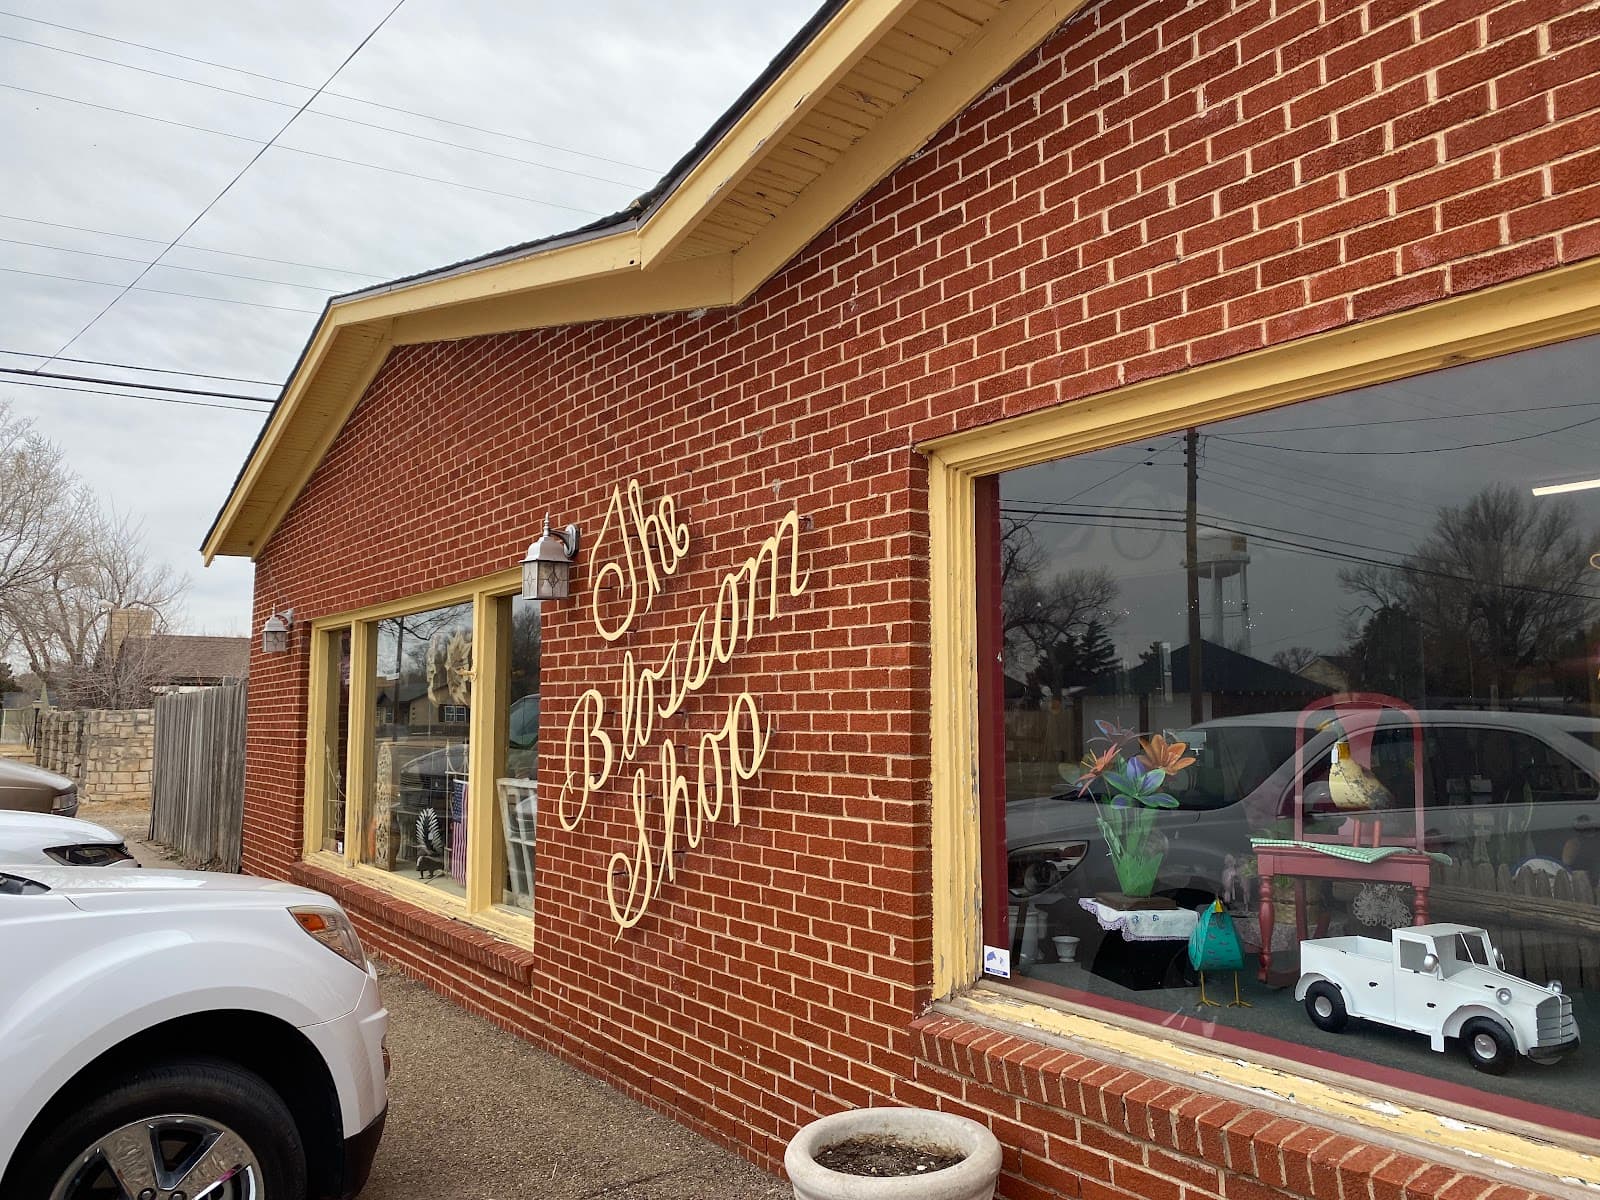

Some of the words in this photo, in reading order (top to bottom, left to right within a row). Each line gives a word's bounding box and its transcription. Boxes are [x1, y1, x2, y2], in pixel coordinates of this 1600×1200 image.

[559, 510, 809, 831] Blossom
[589, 478, 689, 641] The
[607, 692, 772, 944] Shop
